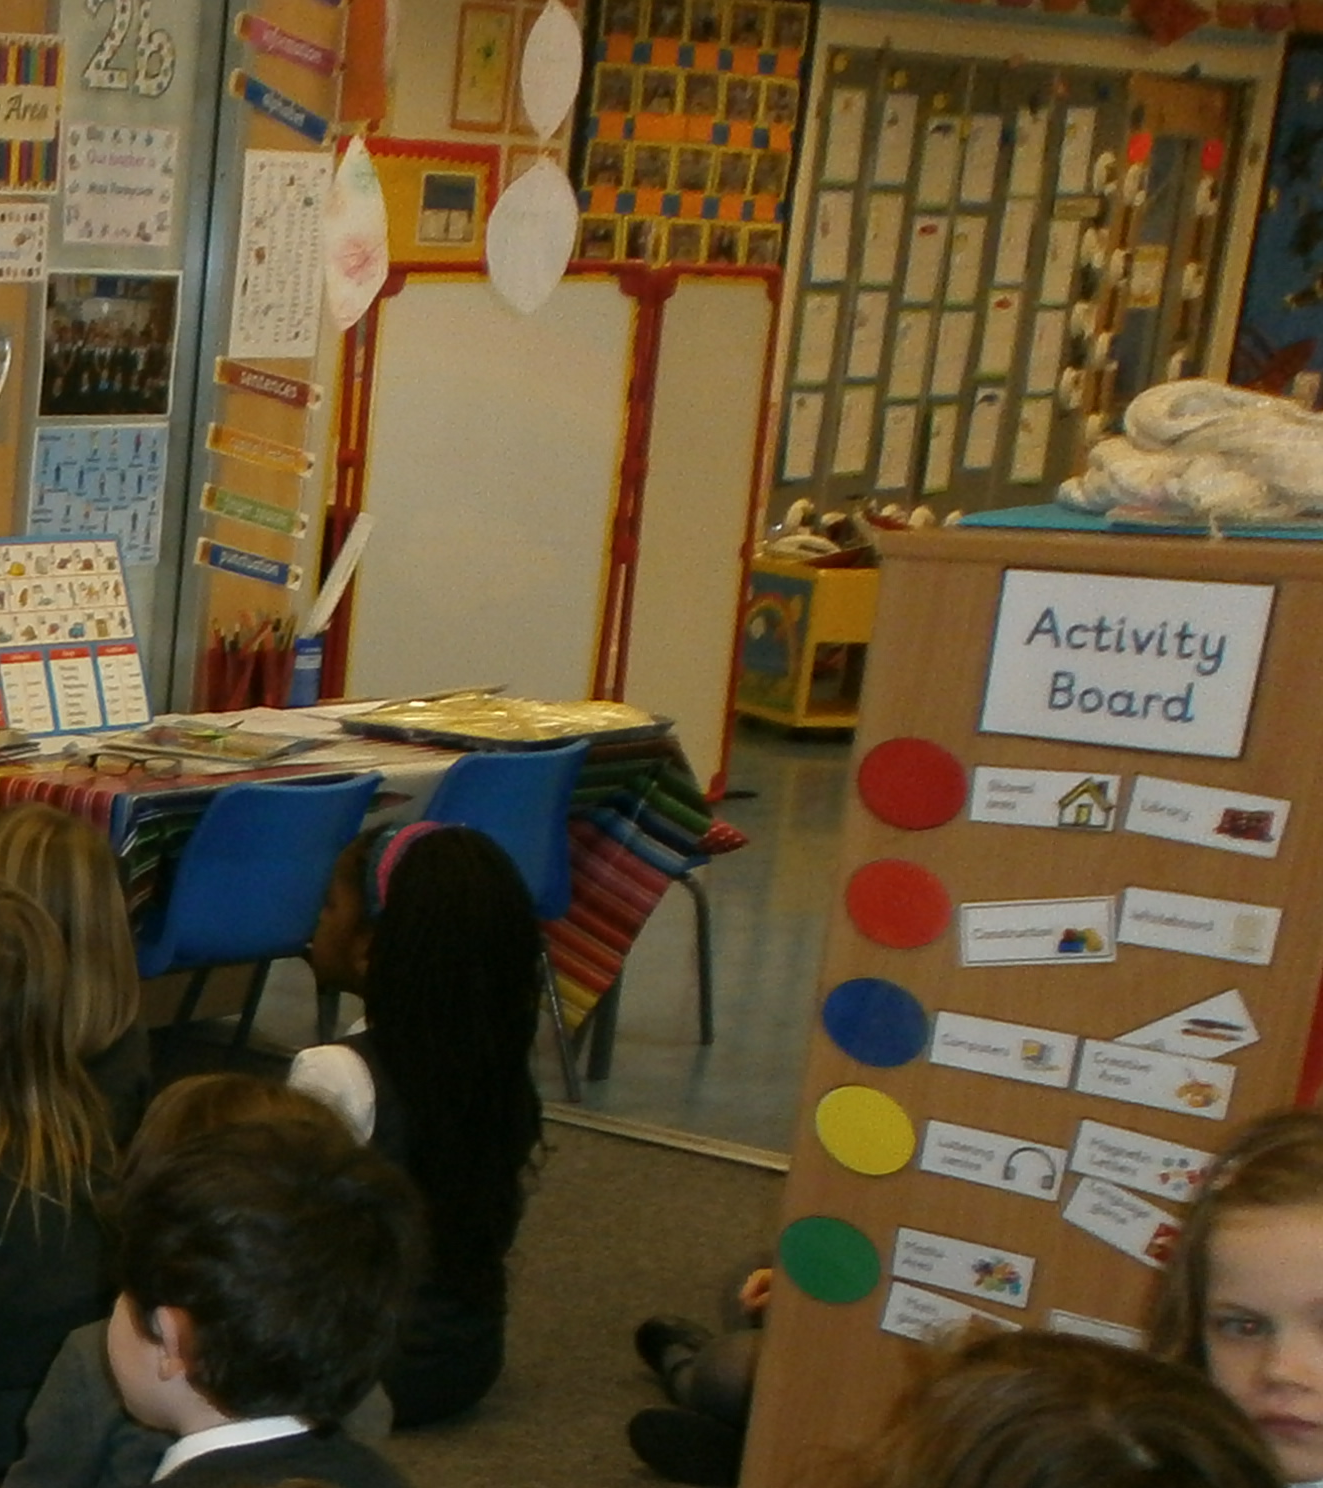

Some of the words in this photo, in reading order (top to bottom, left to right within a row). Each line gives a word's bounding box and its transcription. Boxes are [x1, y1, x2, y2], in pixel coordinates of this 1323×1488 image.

[5, 92, 48, 121] Area
[1024, 607, 1227, 676] Activity
[1047, 670, 1195, 724] Board
